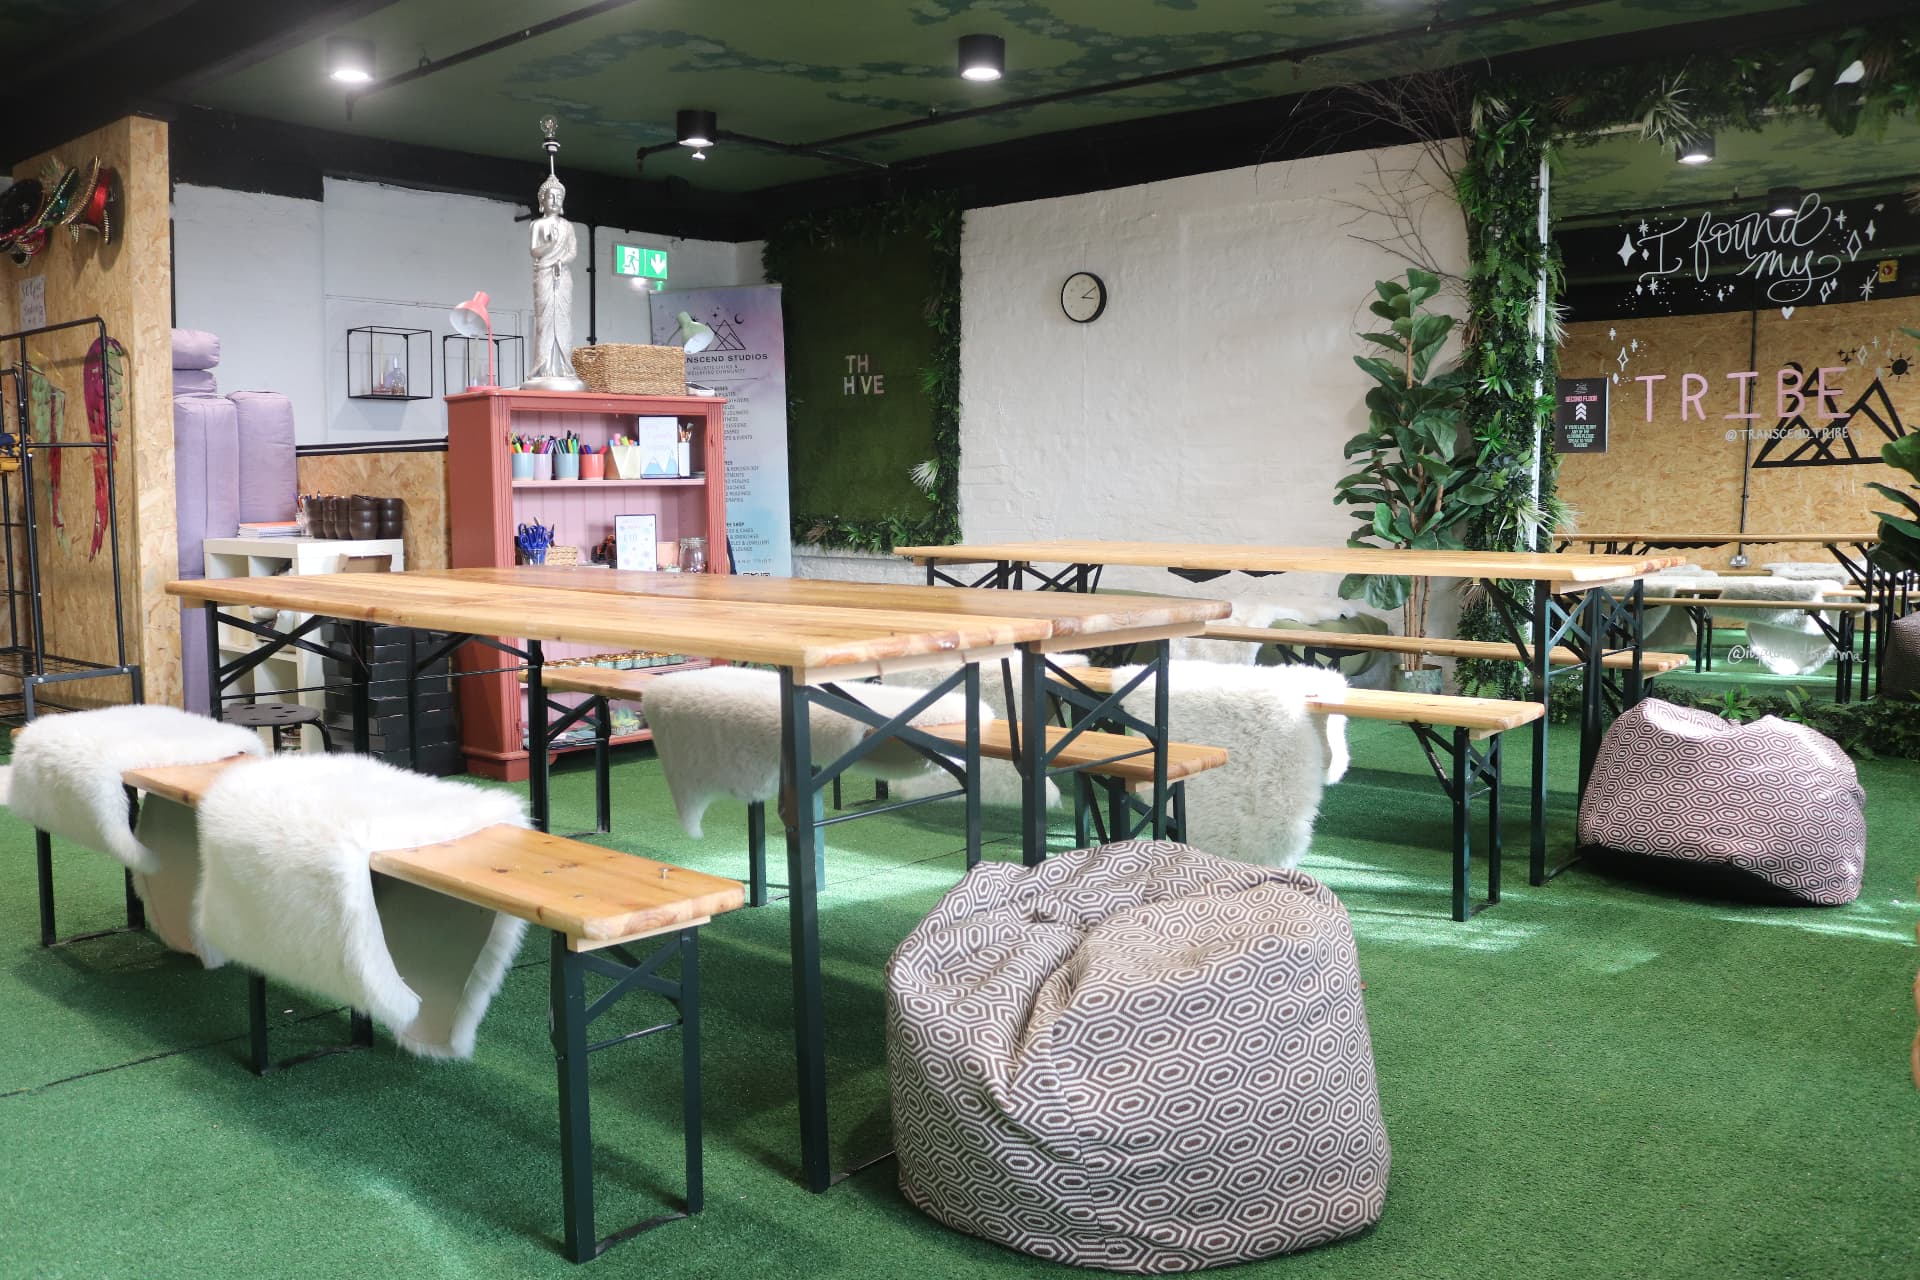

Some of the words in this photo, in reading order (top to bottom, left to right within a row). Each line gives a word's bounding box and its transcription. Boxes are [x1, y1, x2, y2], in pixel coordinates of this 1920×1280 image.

[1689, 193, 1831, 282] found
[1736, 250, 1841, 302] my
[686, 355, 724, 363] NSCEND
[727, 353, 768, 361] STUDIOS
[845, 353, 869, 374] TH
[1635, 367, 1850, 423] TRIBE
[1725, 426, 1849, 442] @TRANSCEND_TRIBE
